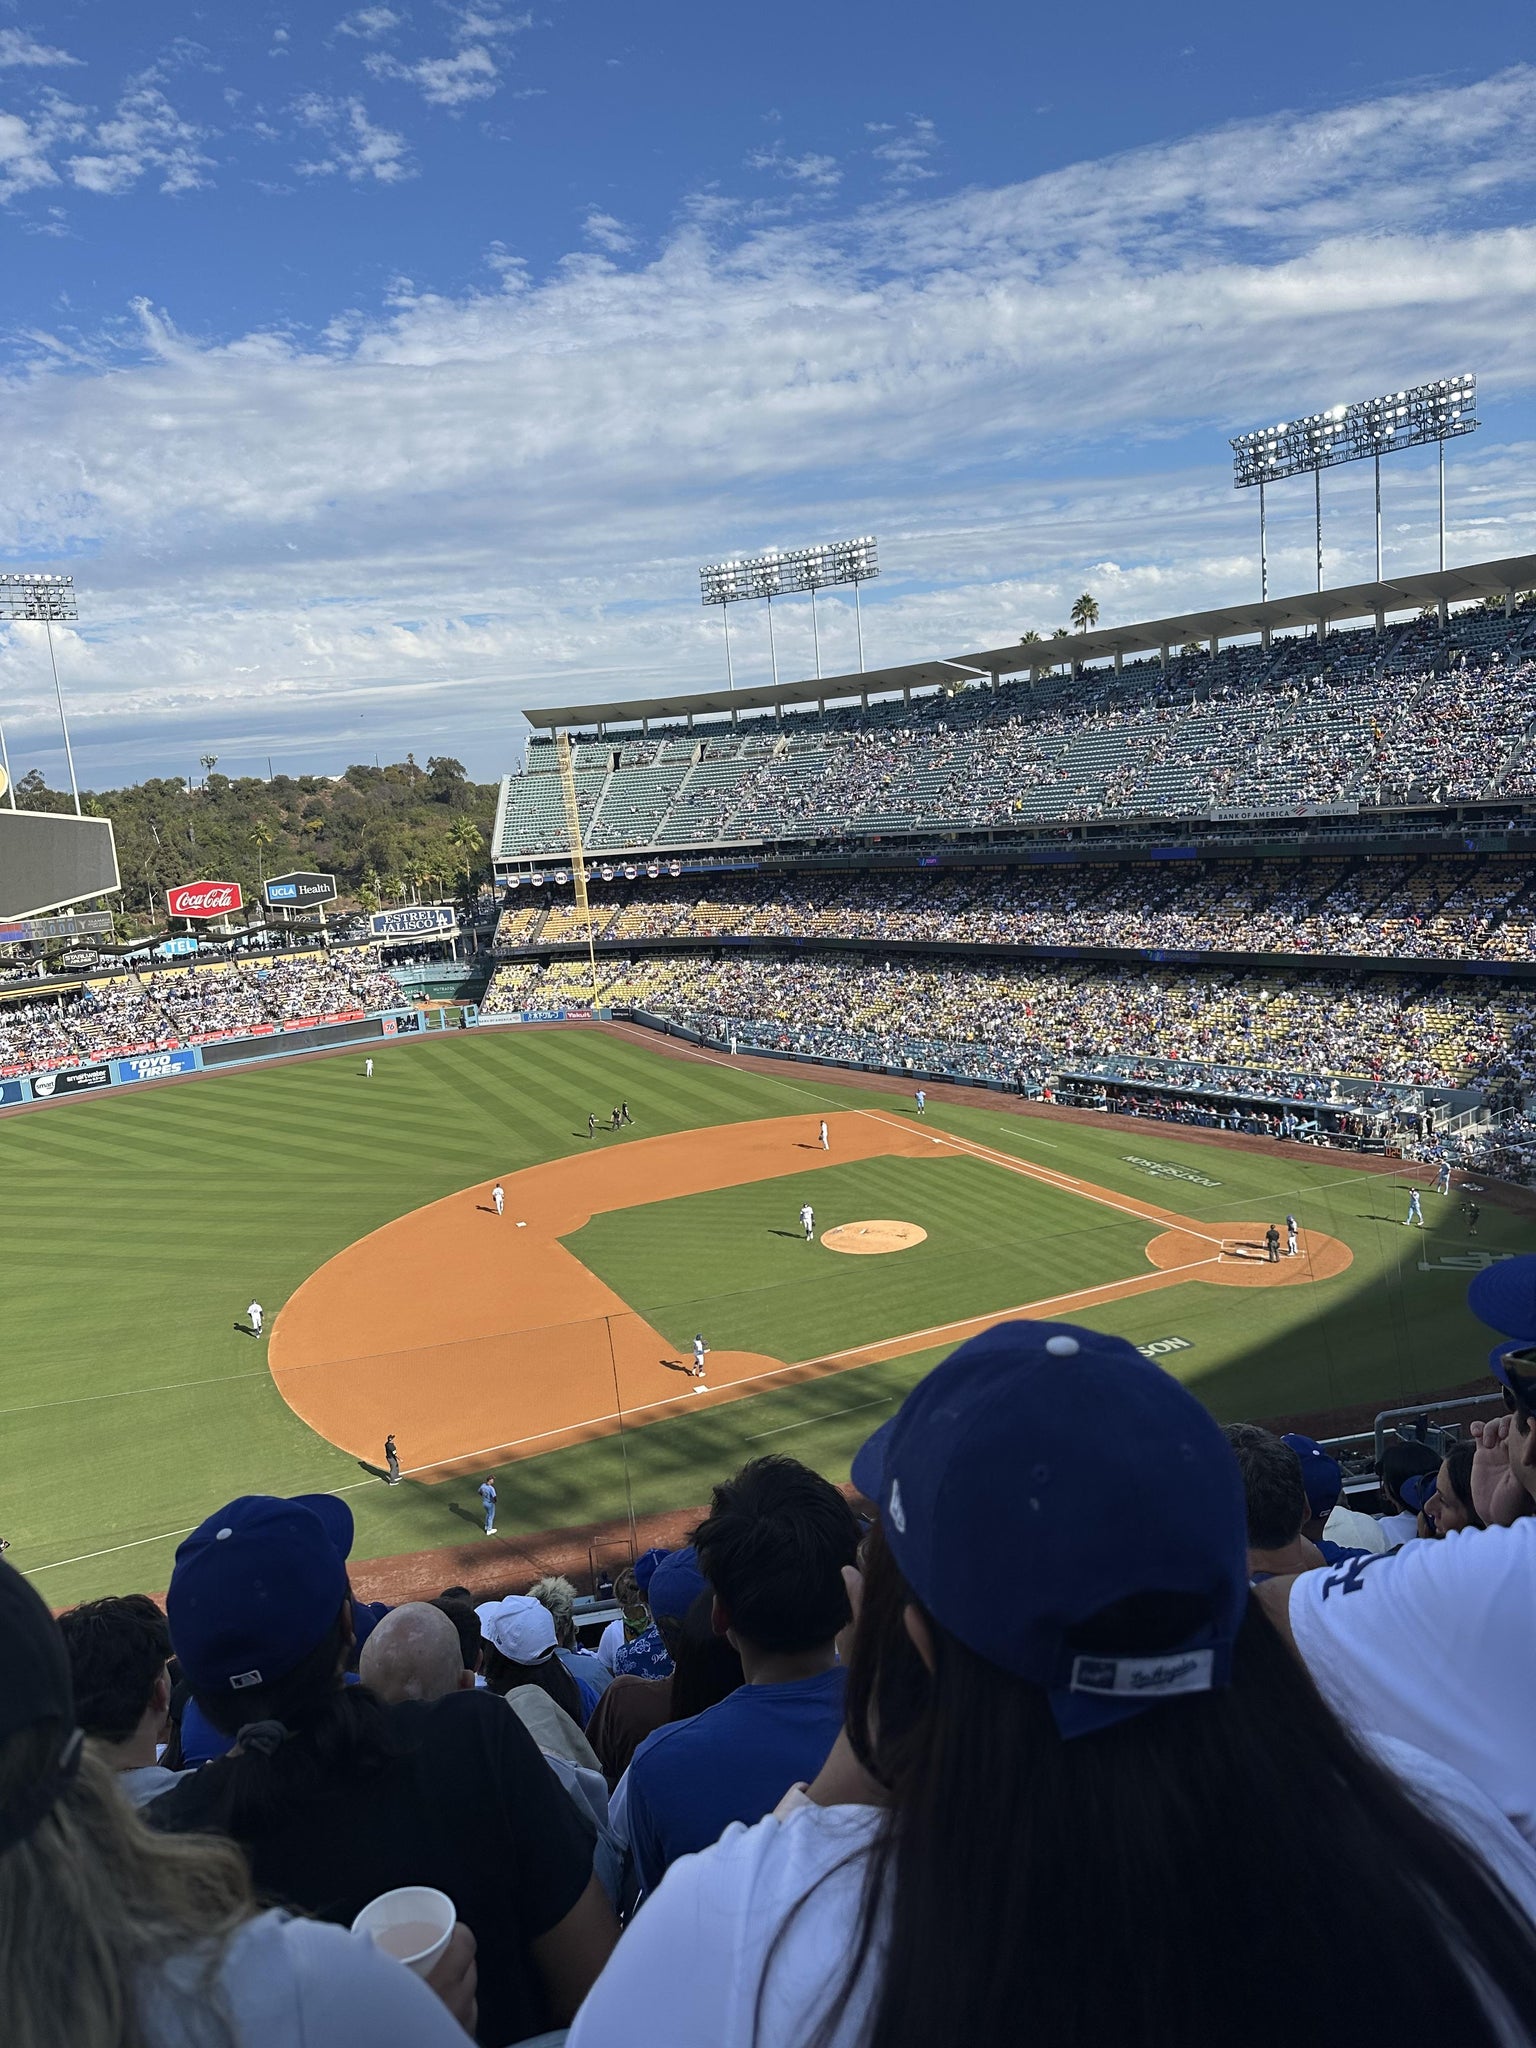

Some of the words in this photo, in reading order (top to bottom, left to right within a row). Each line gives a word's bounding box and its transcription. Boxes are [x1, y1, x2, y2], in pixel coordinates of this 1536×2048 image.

[1218, 812, 1239, 820] BANK
[271, 886, 295, 897] UCLA
[299, 883, 331, 895] Health
[176, 887, 233, 911] Coca-Cola
[380, 919, 433, 932] JALISCO
[168, 940, 194, 952] TEL
[64, 952, 96, 961] STARLUX
[386, 1023, 395, 1031] 76
[130, 1055, 171, 1070] TOYO
[66, 1070, 107, 1082] smartwater
[138, 1062, 183, 1078] TIRES
[1121, 1155, 1222, 1187] POSTSEASON
[1151, 1658, 1197, 1683] Angeles
